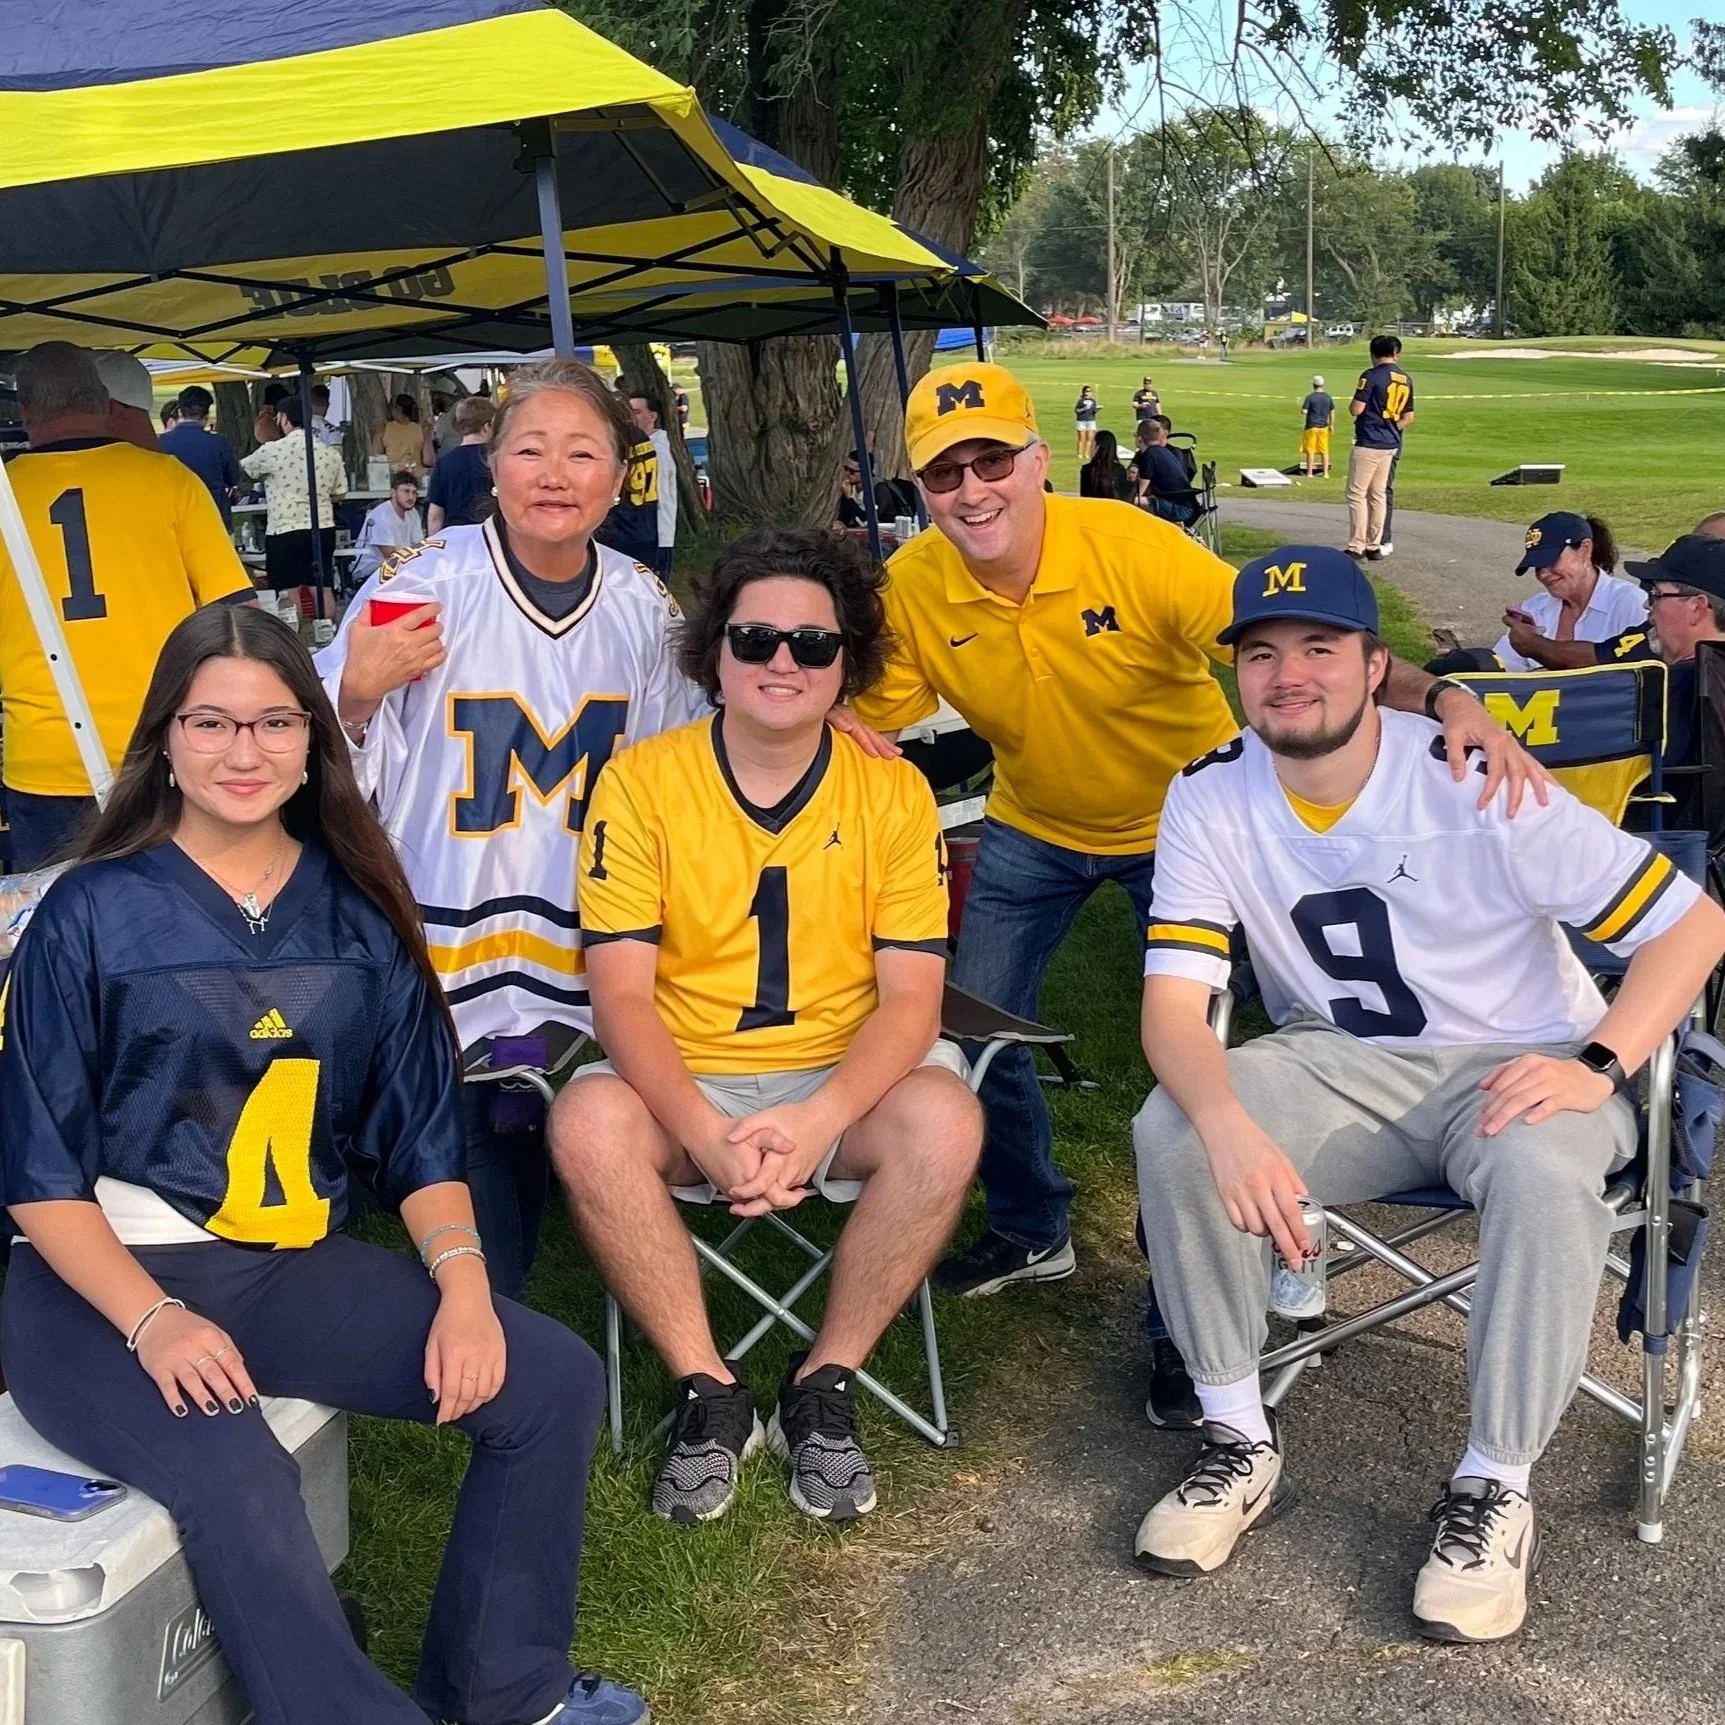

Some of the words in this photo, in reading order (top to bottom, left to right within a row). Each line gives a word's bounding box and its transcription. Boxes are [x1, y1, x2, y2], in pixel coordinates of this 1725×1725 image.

[935, 379, 986, 417] M
[1382, 382, 1410, 422] 10
[629, 457, 659, 507] 97
[48, 487, 108, 622] 1
[1262, 561, 1309, 598] M
[1080, 604, 1124, 638] M
[1613, 632, 1647, 659] 4
[1484, 689, 1561, 747] M
[445, 689, 630, 840] M
[588, 820, 608, 881] 1
[735, 866, 797, 1033] 1
[1289, 886, 1429, 1038] 9
[249, 1026, 293, 1040] adidas
[203, 1058, 331, 1251] 4
